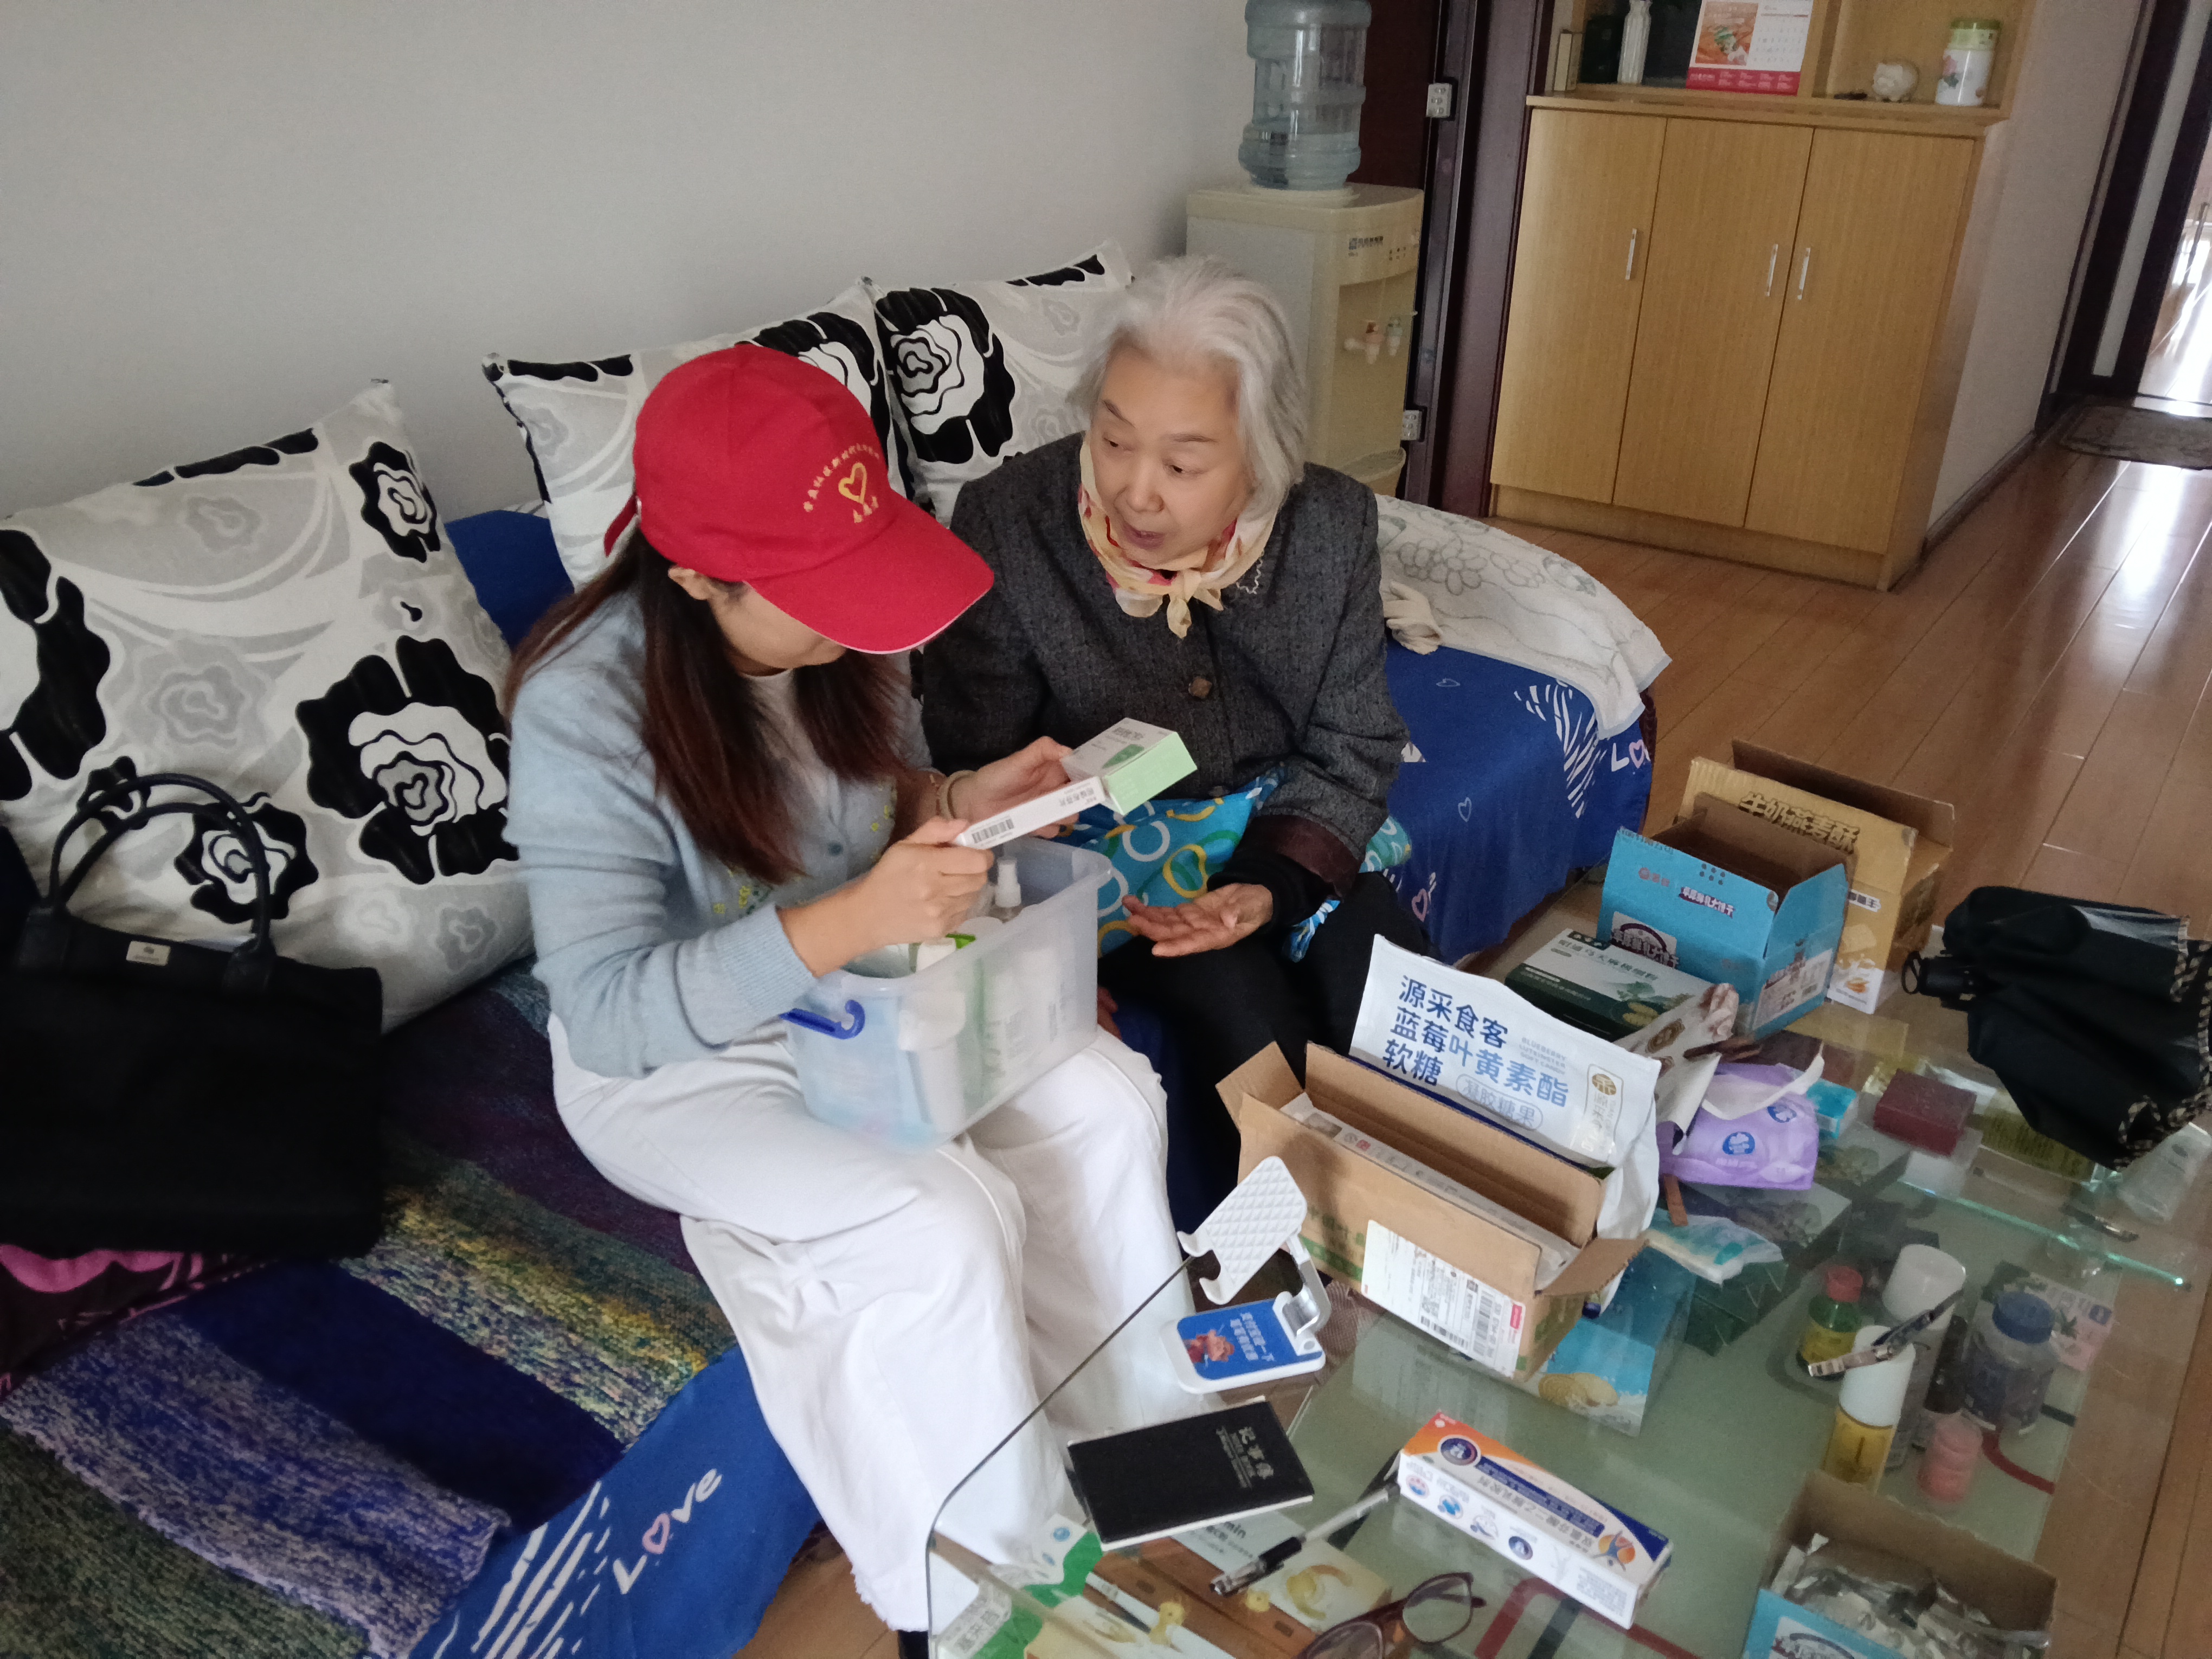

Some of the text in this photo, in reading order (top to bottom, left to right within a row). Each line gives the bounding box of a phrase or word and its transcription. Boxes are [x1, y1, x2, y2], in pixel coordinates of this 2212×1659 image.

[1739, 791, 1860, 855] 牛奶燕麦酥
[1398, 975, 1508, 1049] 源采食客
[1382, 1039, 1443, 1086] 软糖
[1390, 1006, 1568, 1107] 蓝莓叶黄素酯
[613, 1468, 722, 1594] Love
